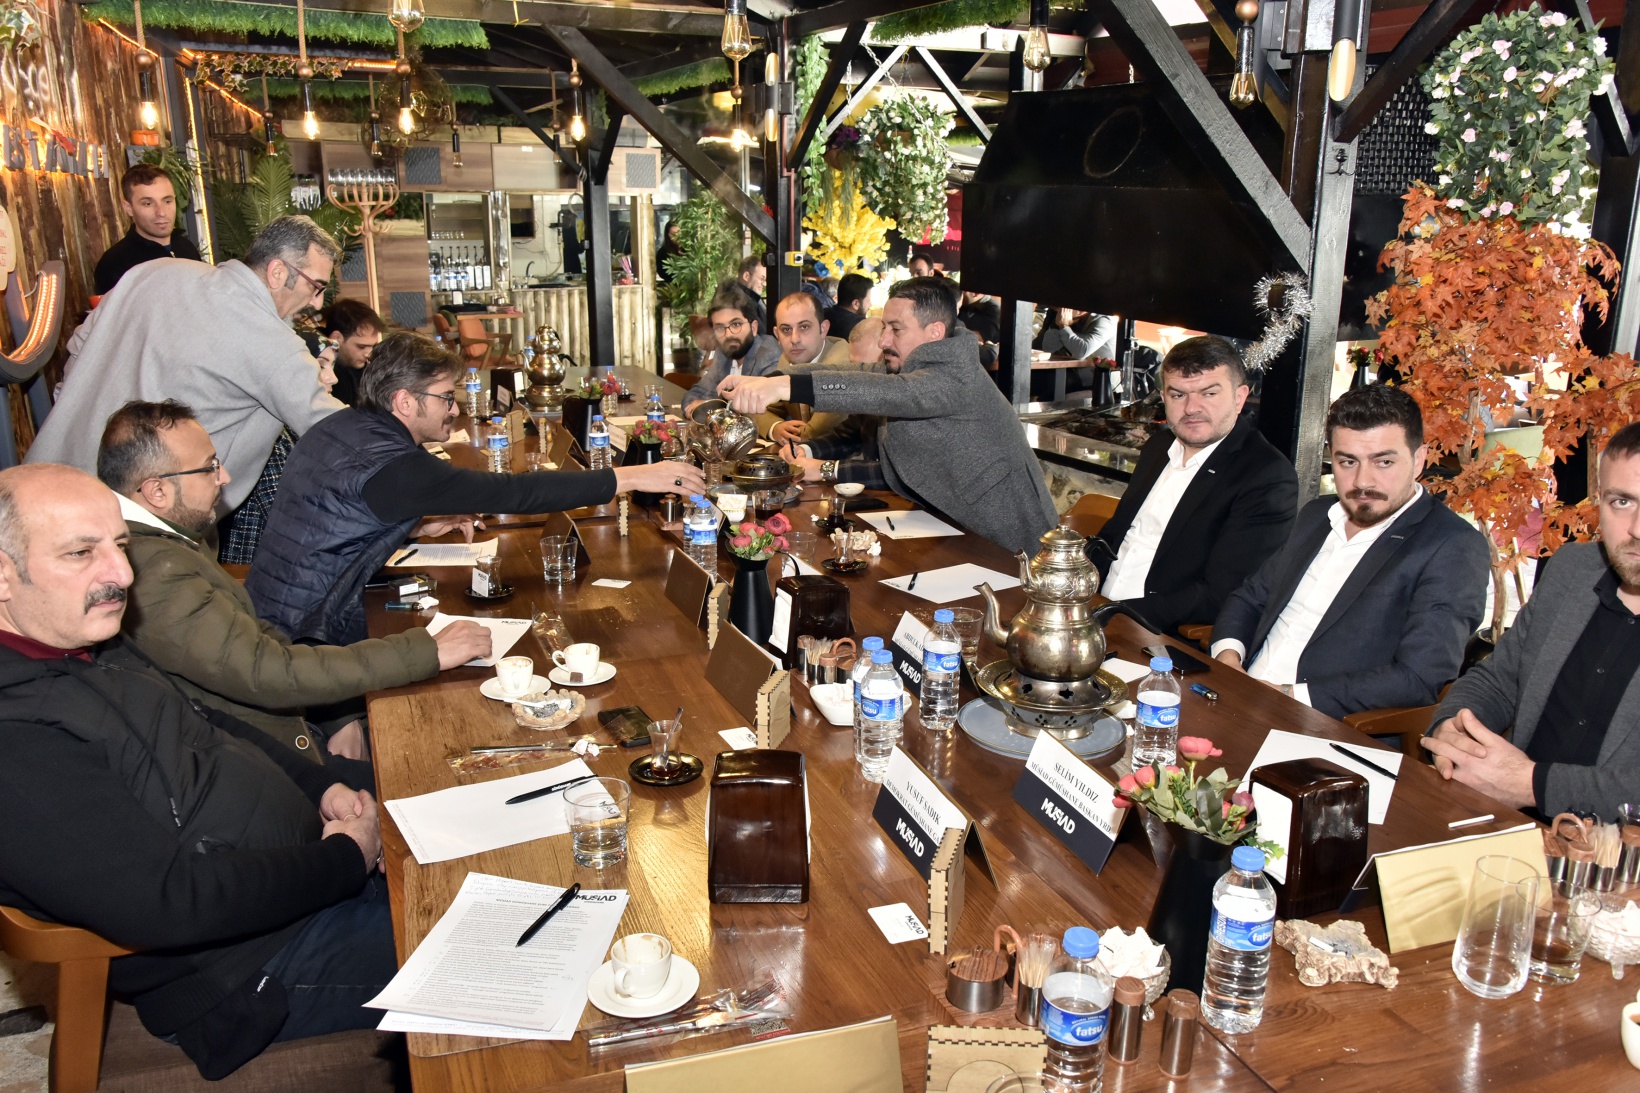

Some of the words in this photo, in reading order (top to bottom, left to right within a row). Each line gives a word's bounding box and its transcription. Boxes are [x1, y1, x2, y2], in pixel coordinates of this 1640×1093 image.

[906, 781, 924, 805] YUSUF
[923, 801, 942, 825] SADIK
[1053, 762, 1075, 785] SELİM
[1074, 778, 1099, 804] YILDIZ
[1075, 1024, 1104, 1037] fatsu
